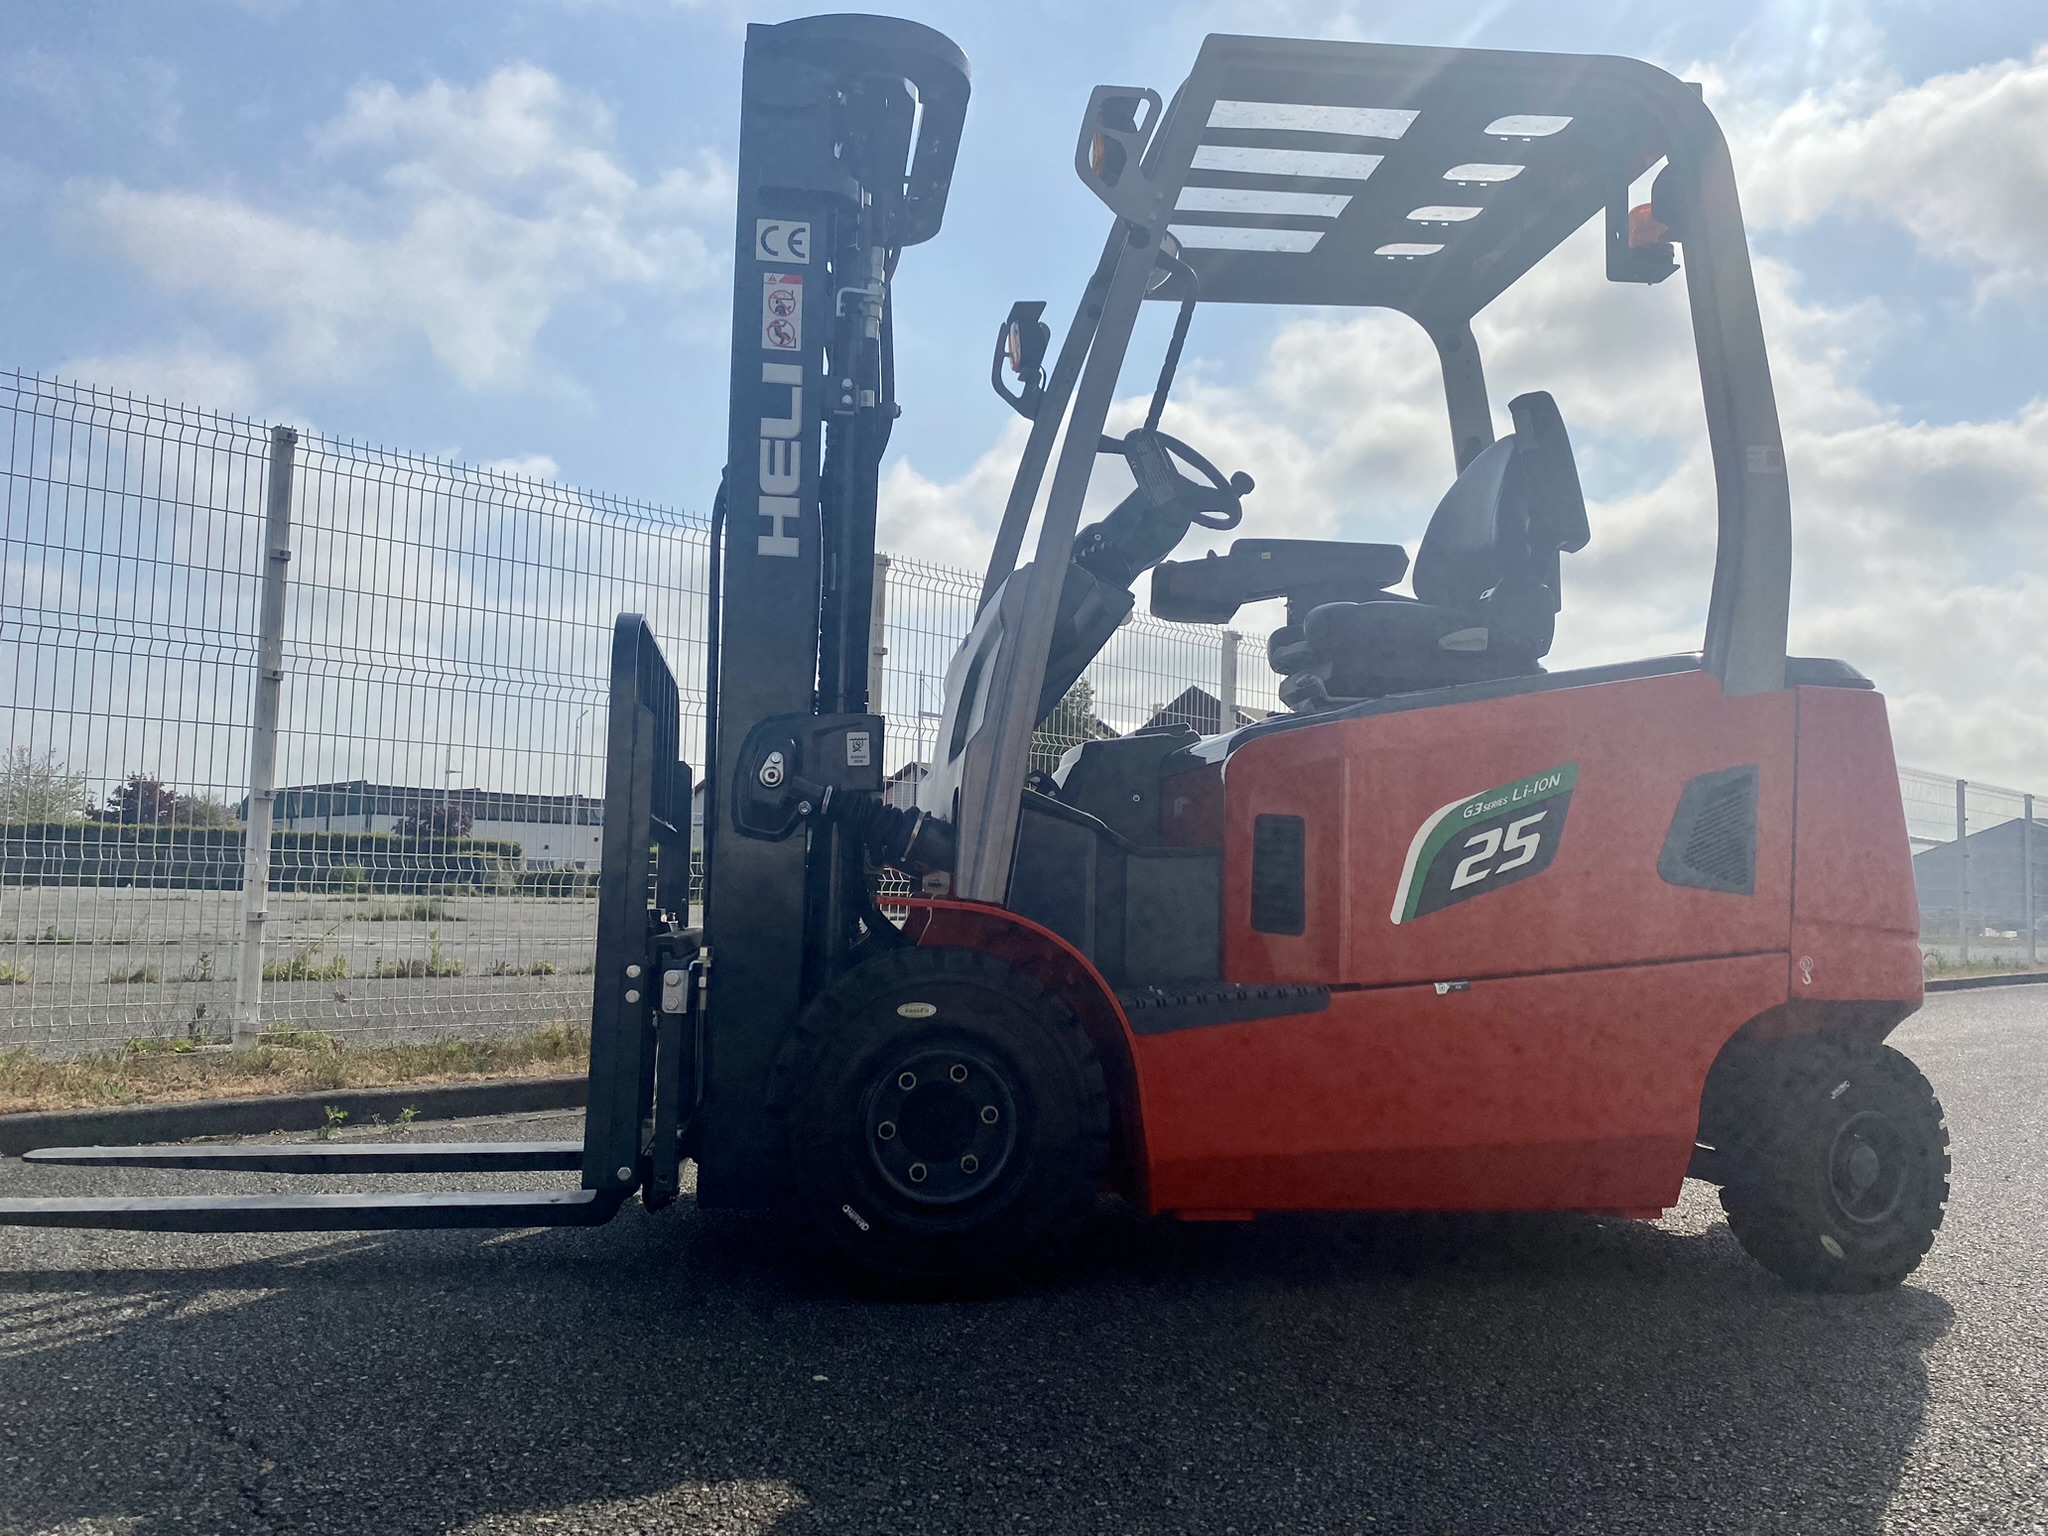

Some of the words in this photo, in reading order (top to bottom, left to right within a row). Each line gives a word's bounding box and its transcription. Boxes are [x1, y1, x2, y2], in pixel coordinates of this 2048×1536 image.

[760, 225, 806, 259] CE
[757, 362, 804, 558] HELI
[1512, 772, 1562, 802] Li-ION
[1450, 810, 1549, 891] 25
